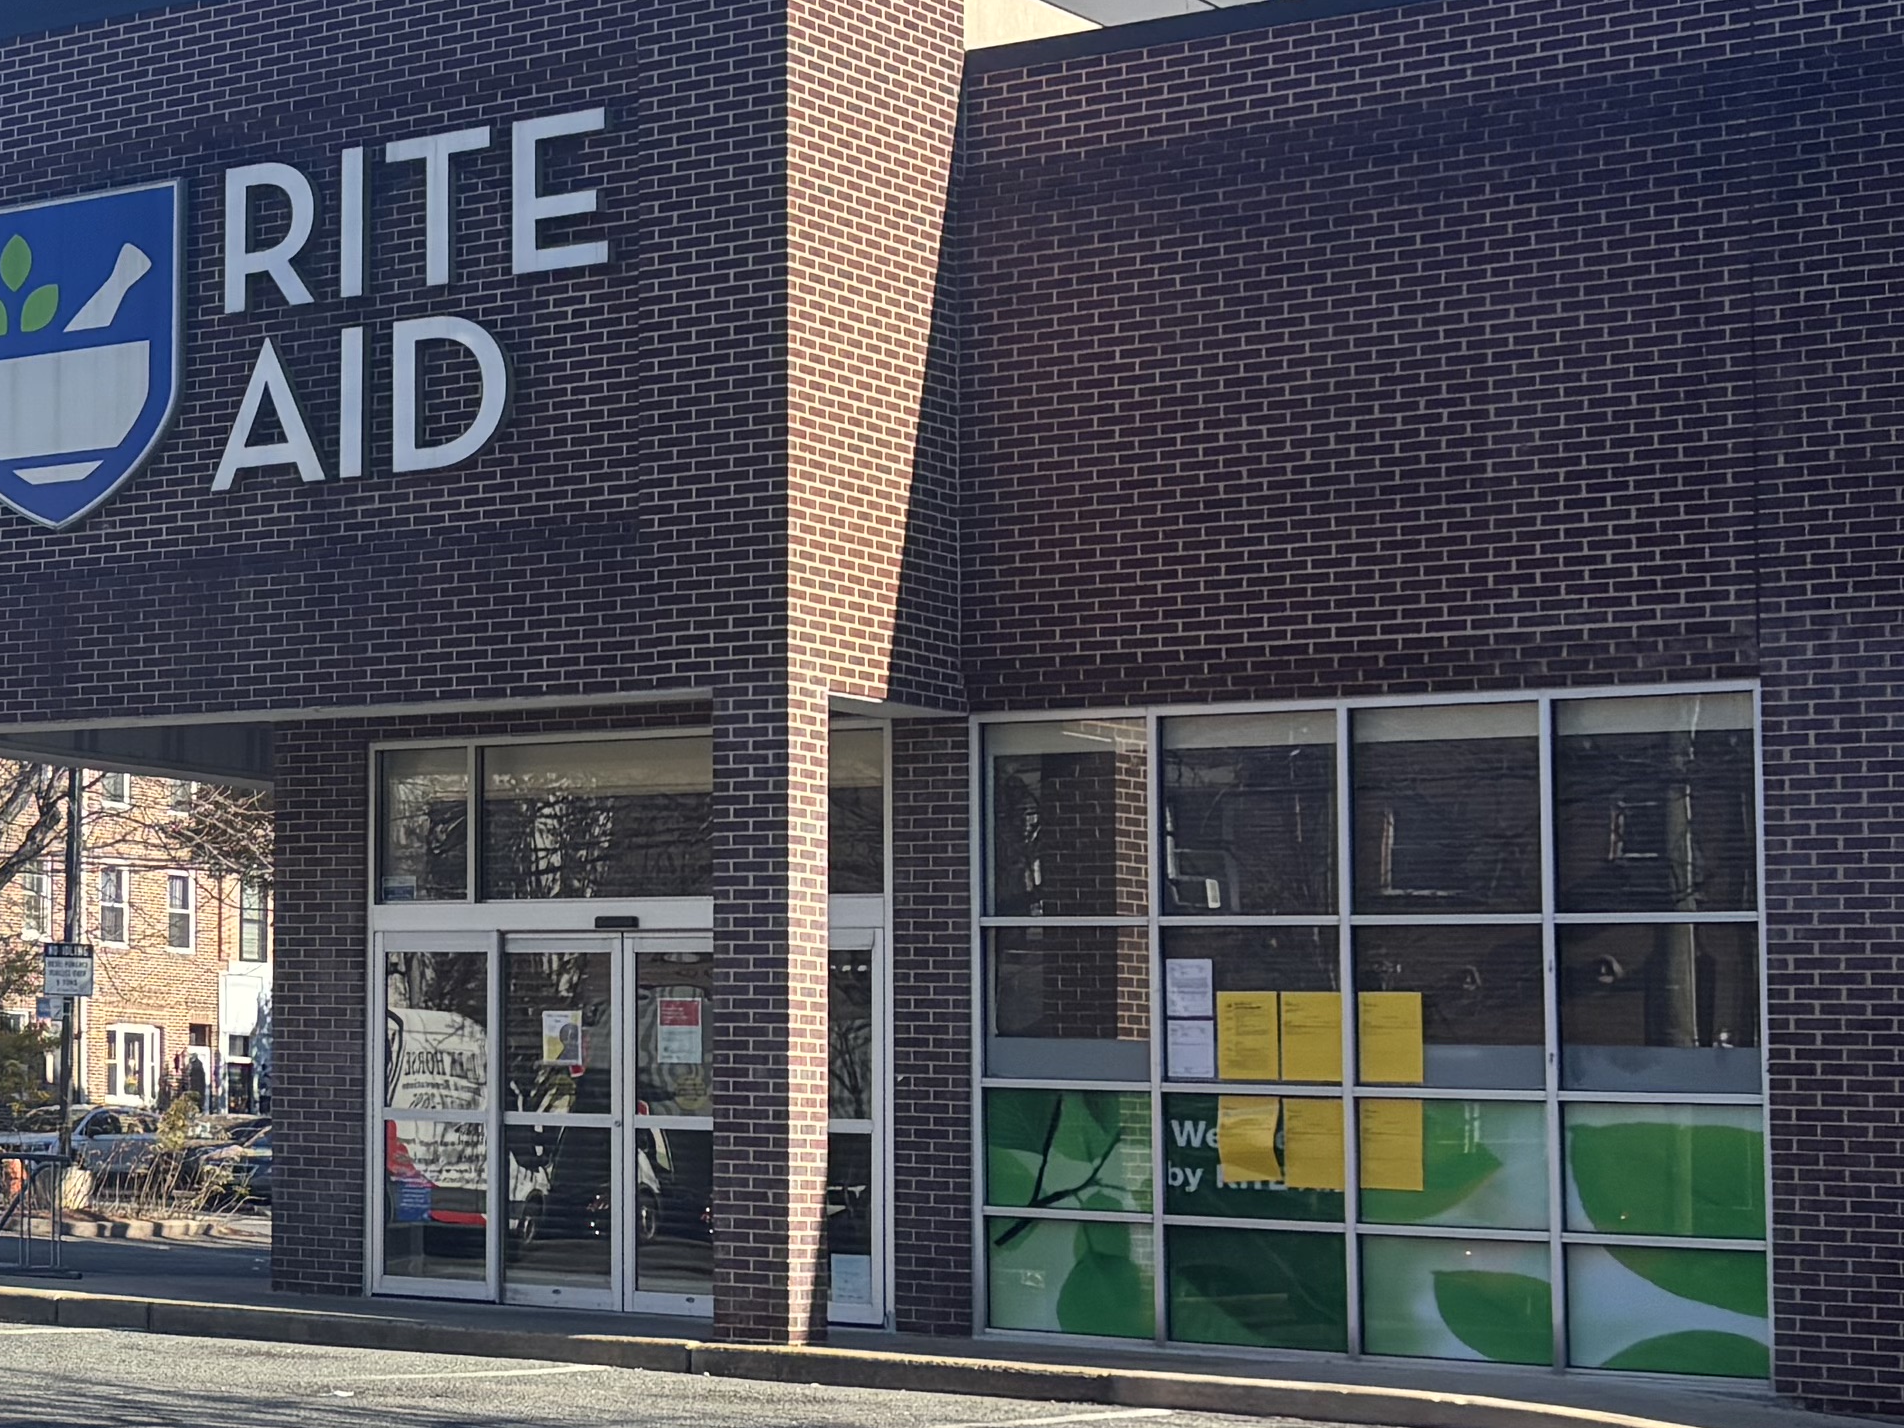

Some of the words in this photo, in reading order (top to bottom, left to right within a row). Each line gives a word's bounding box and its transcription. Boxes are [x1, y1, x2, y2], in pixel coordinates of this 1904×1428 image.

[223, 107, 609, 315] RITE
[210, 316, 508, 493] AID
[1167, 1160, 1204, 1192] by
